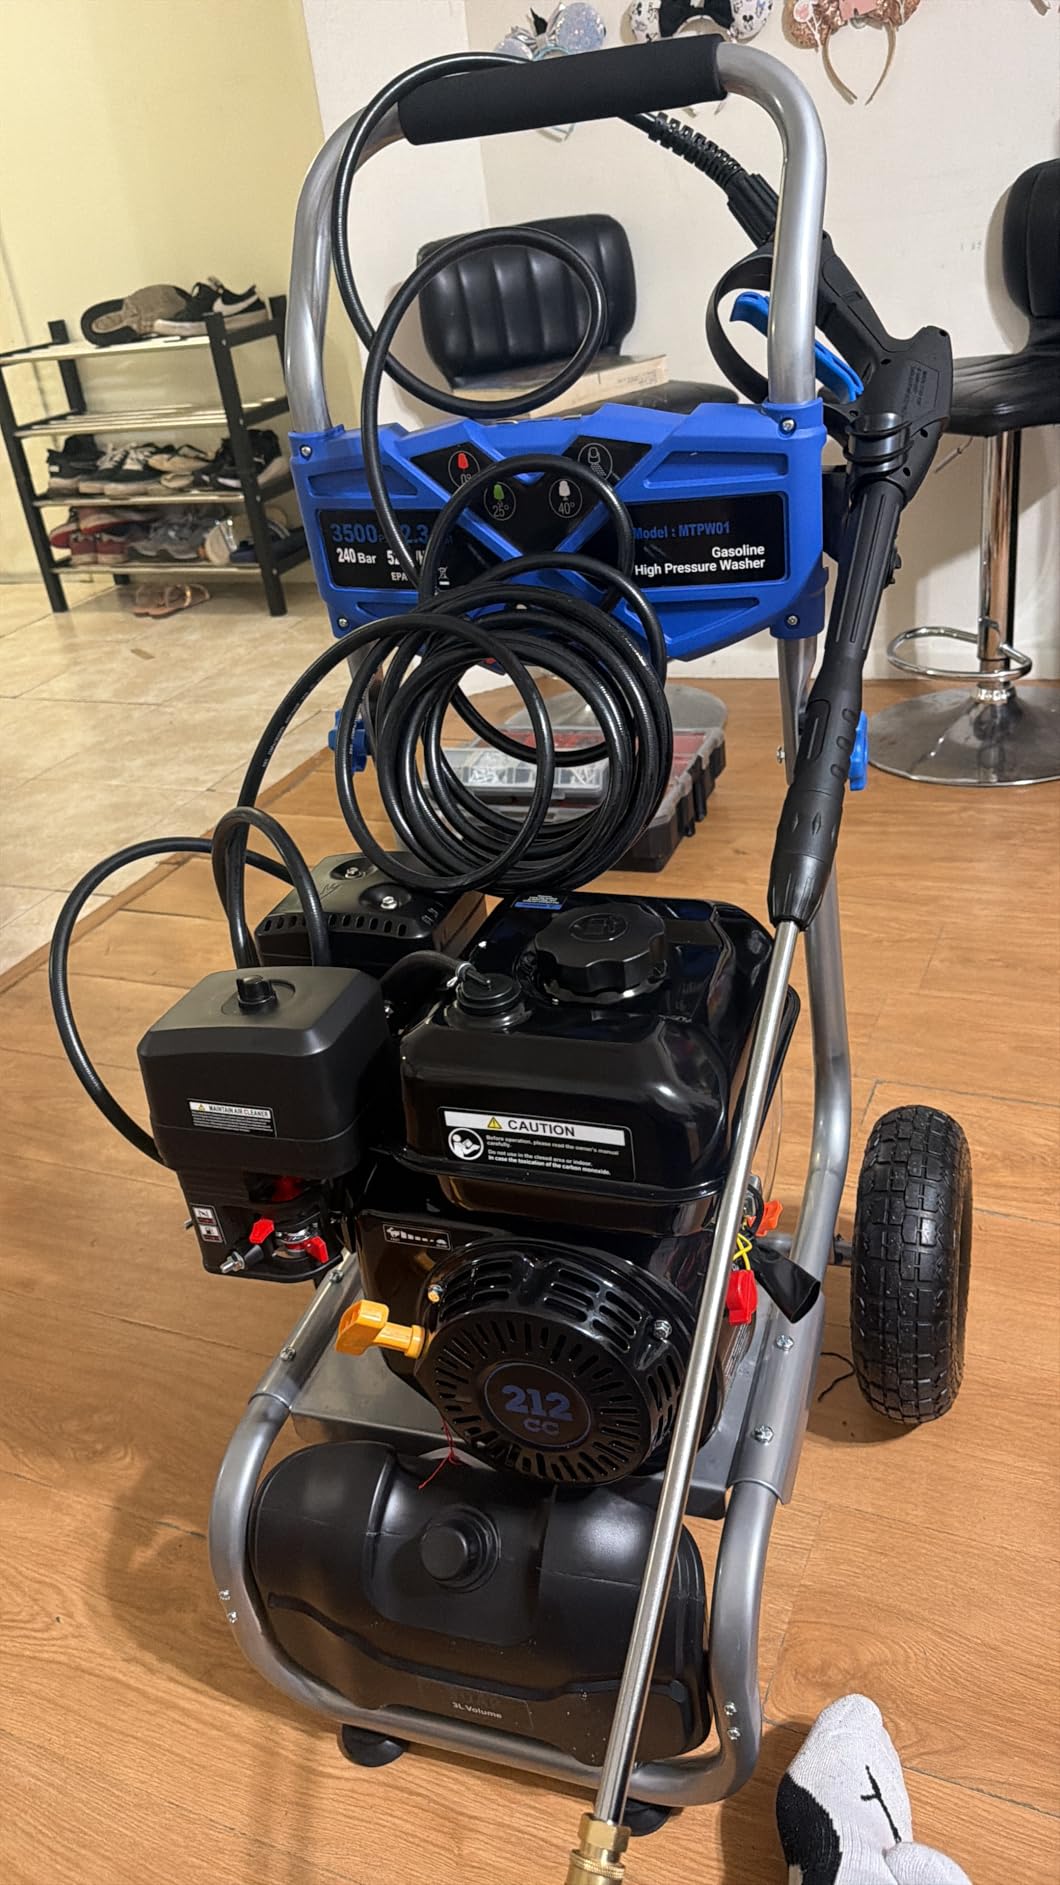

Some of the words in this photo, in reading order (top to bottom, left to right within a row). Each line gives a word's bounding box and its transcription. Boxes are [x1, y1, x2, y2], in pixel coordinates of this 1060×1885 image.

[330, 523, 378, 544] 3500
[632, 526, 668, 540] Model
[678, 521, 731, 537] MTPW01
[336, 548, 357, 563] 240
[357, 552, 377, 564] Bar
[711, 544, 766, 559] Gasoline
[390, 571, 409, 582] EPA
[634, 563, 662, 578] High
[664, 560, 717, 574] Pressure
[719, 558, 766, 572] Washer
[209, 1105, 233, 1114] MAINTAIN
[507, 1119, 576, 1138] CAUTION
[501, 1384, 574, 1422] 212
[465, 1704, 503, 1719] Volume
